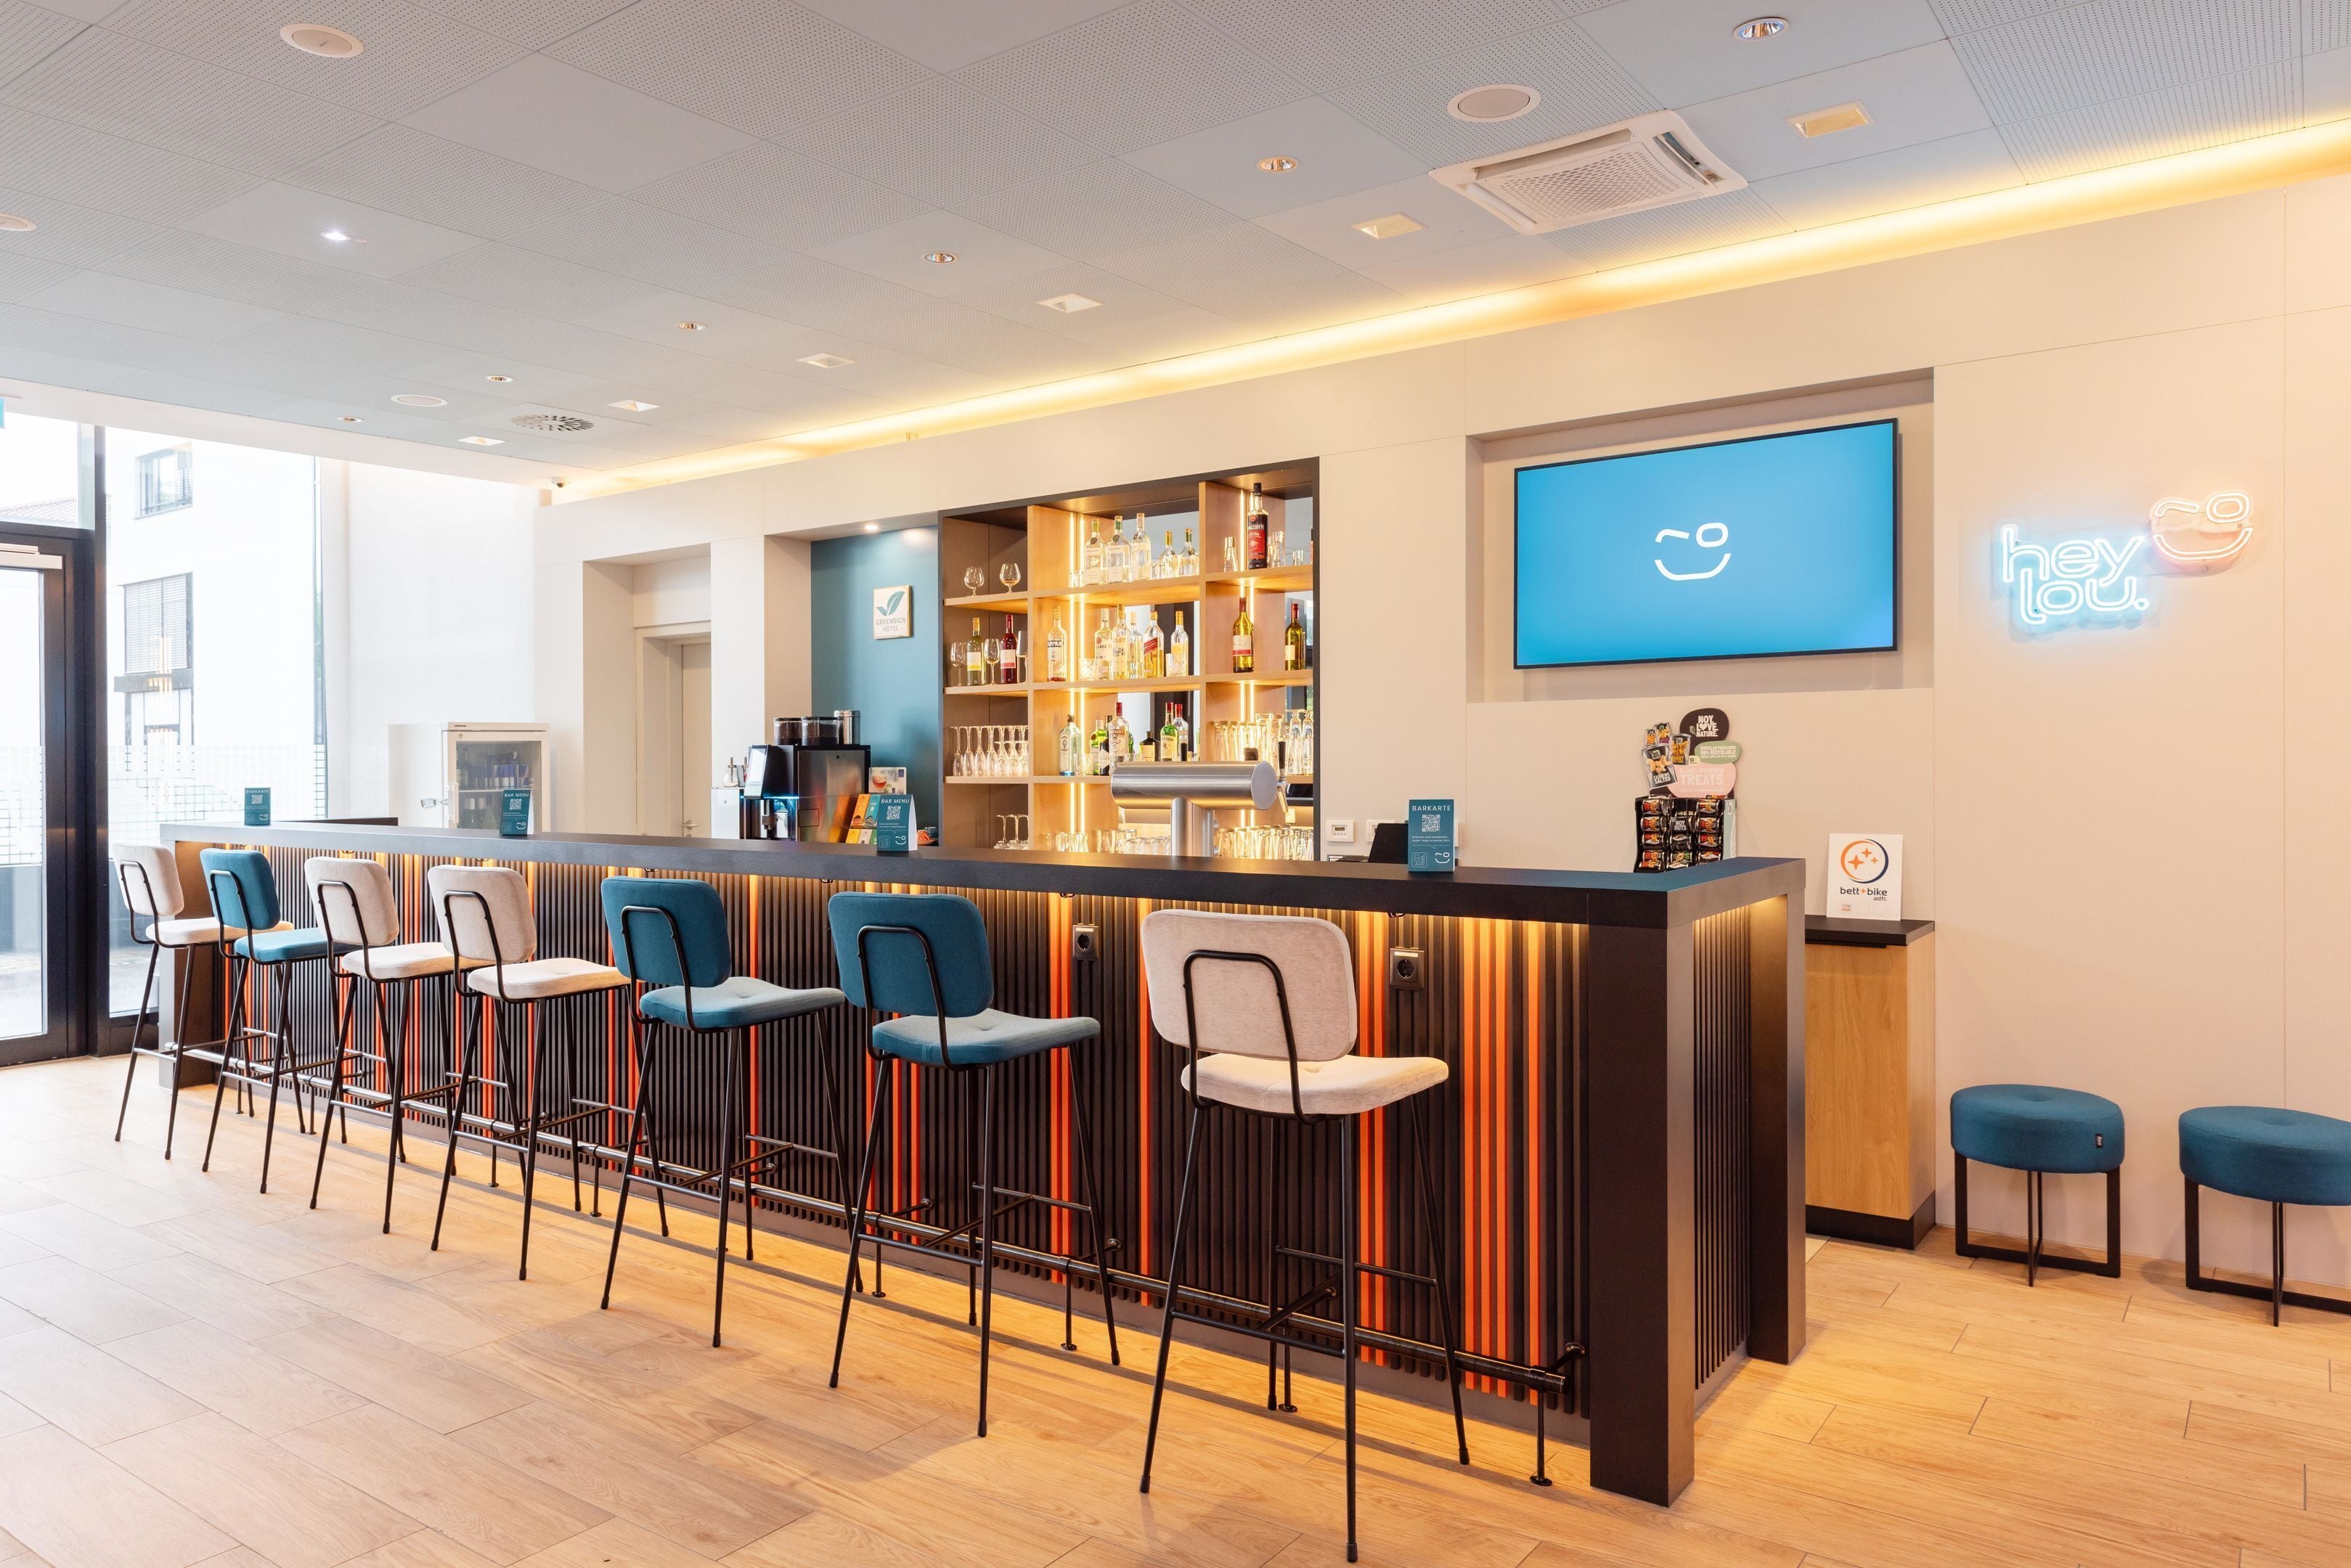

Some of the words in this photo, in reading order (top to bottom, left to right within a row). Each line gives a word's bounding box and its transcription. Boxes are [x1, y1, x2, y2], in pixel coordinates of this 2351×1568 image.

[2000, 524, 2145, 587] hey
[2020, 568, 2149, 625] lou.
[876, 617, 906, 626] GREENSIGN
[1681, 774, 1724, 785] TREATS
